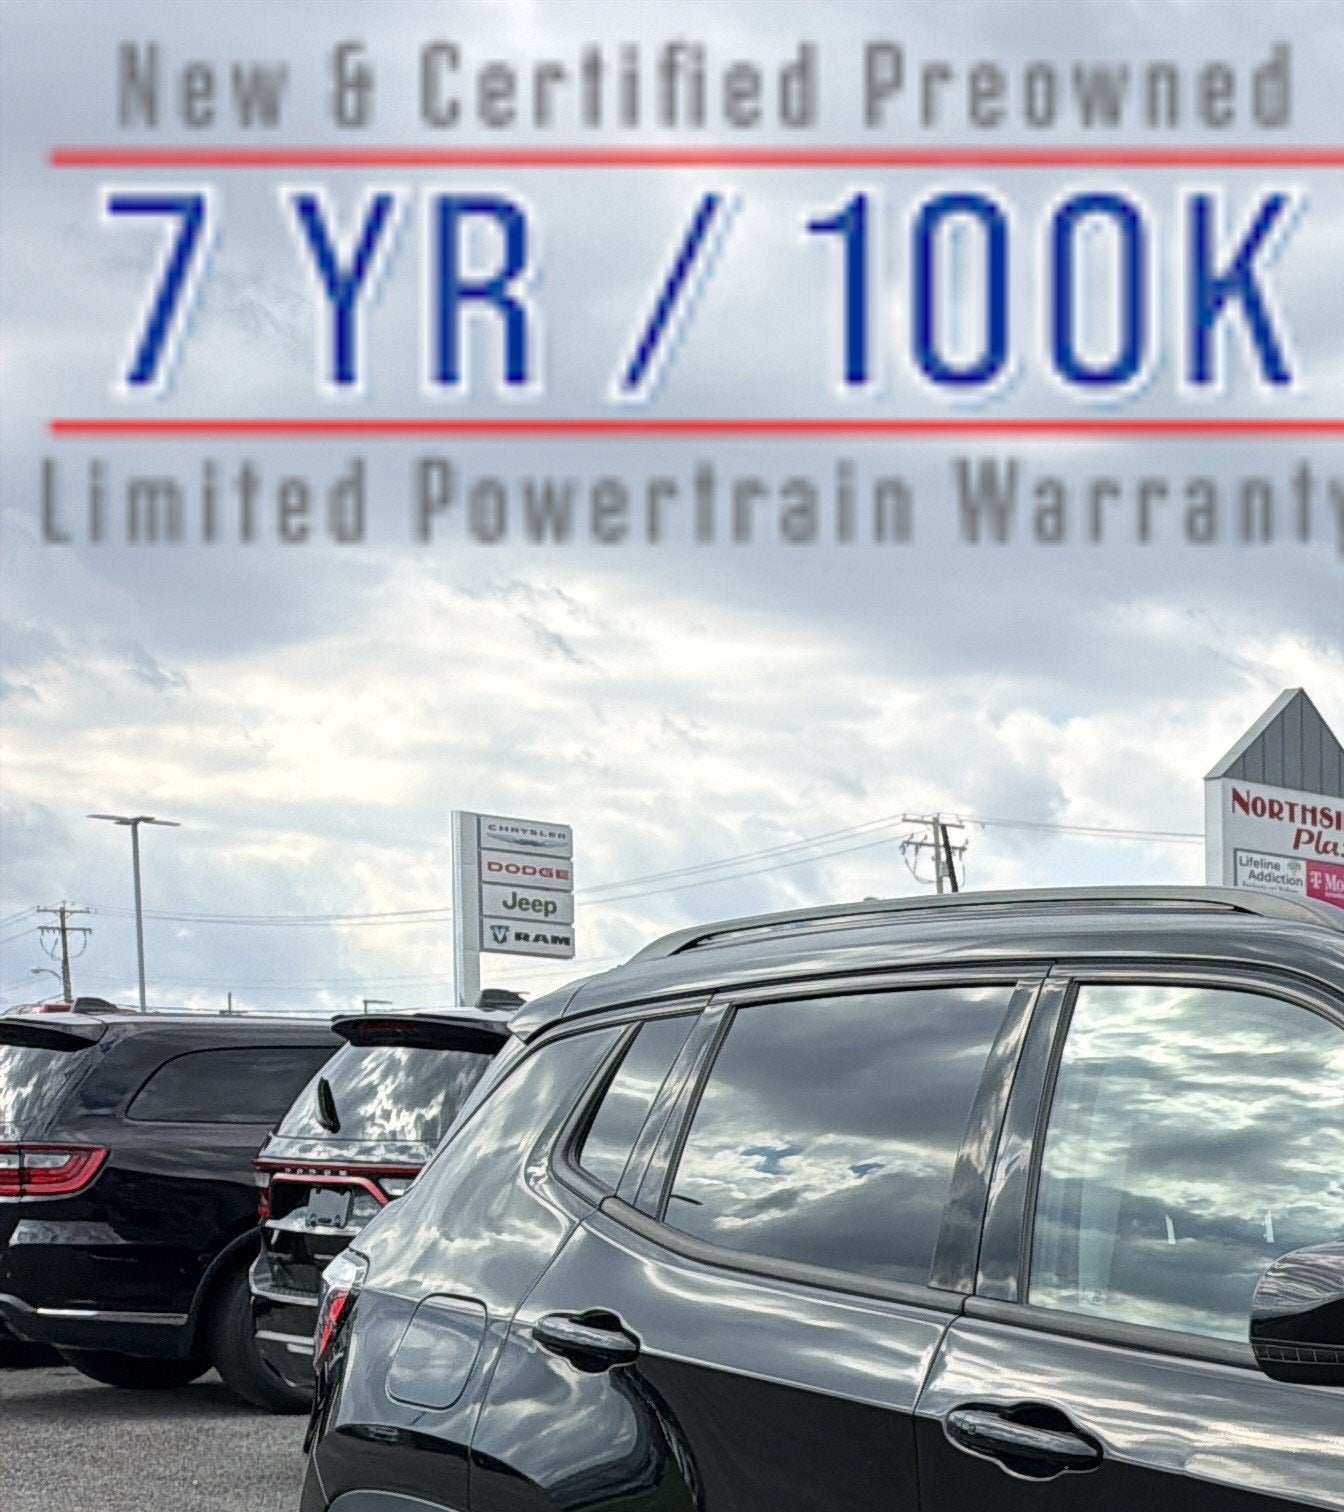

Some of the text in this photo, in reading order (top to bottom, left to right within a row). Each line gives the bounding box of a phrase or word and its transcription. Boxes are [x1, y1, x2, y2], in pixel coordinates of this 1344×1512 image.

[487, 861, 570, 880] DODGE
[1239, 855, 1281, 871] Lifeline
[1248, 869, 1304, 888] Addiction
[502, 891, 557, 917] Jeep
[514, 930, 571, 946] RAM
